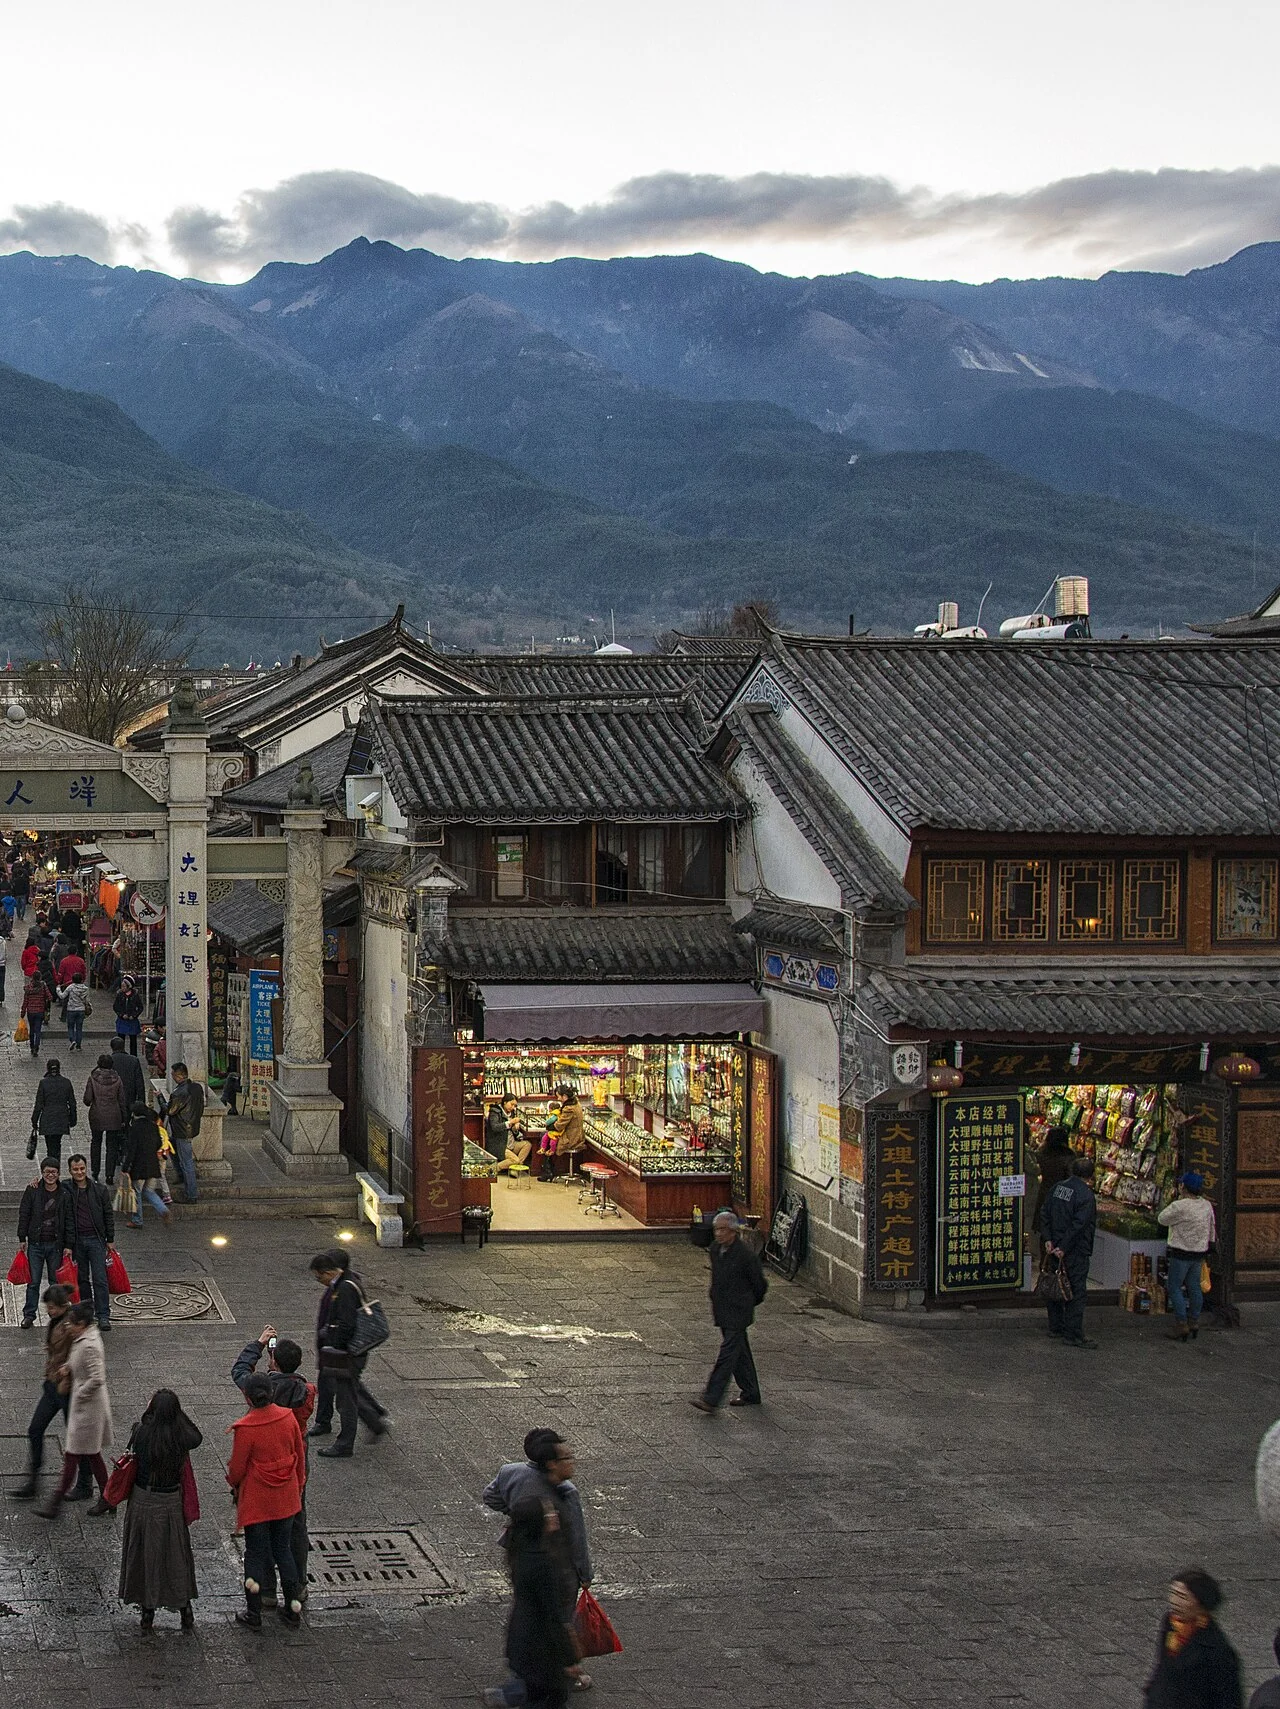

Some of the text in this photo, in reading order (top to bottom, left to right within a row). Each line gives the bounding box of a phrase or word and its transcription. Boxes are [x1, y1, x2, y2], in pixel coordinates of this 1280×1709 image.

[252, 1065, 273, 1078] 旅游线
[962, 1053, 1195, 1075] 大理土特产超市
[955, 1104, 1007, 1121] 本店经营
[424, 1052, 450, 1208] 新华传统手工艺
[949, 1123, 1014, 1139] 大理雕梅脆梅
[949, 1137, 1014, 1153] 大理野生山菌
[949, 1151, 1014, 1167] 云南普洱茗茶
[949, 1166, 1014, 1181] 云南小粒咖啡
[880, 1123, 915, 1278] 大理土特产超市
[948, 1222, 1013, 1238] 程海湖螺旋藻
[948, 1250, 1015, 1266] 雕梅酒 青梅酒
